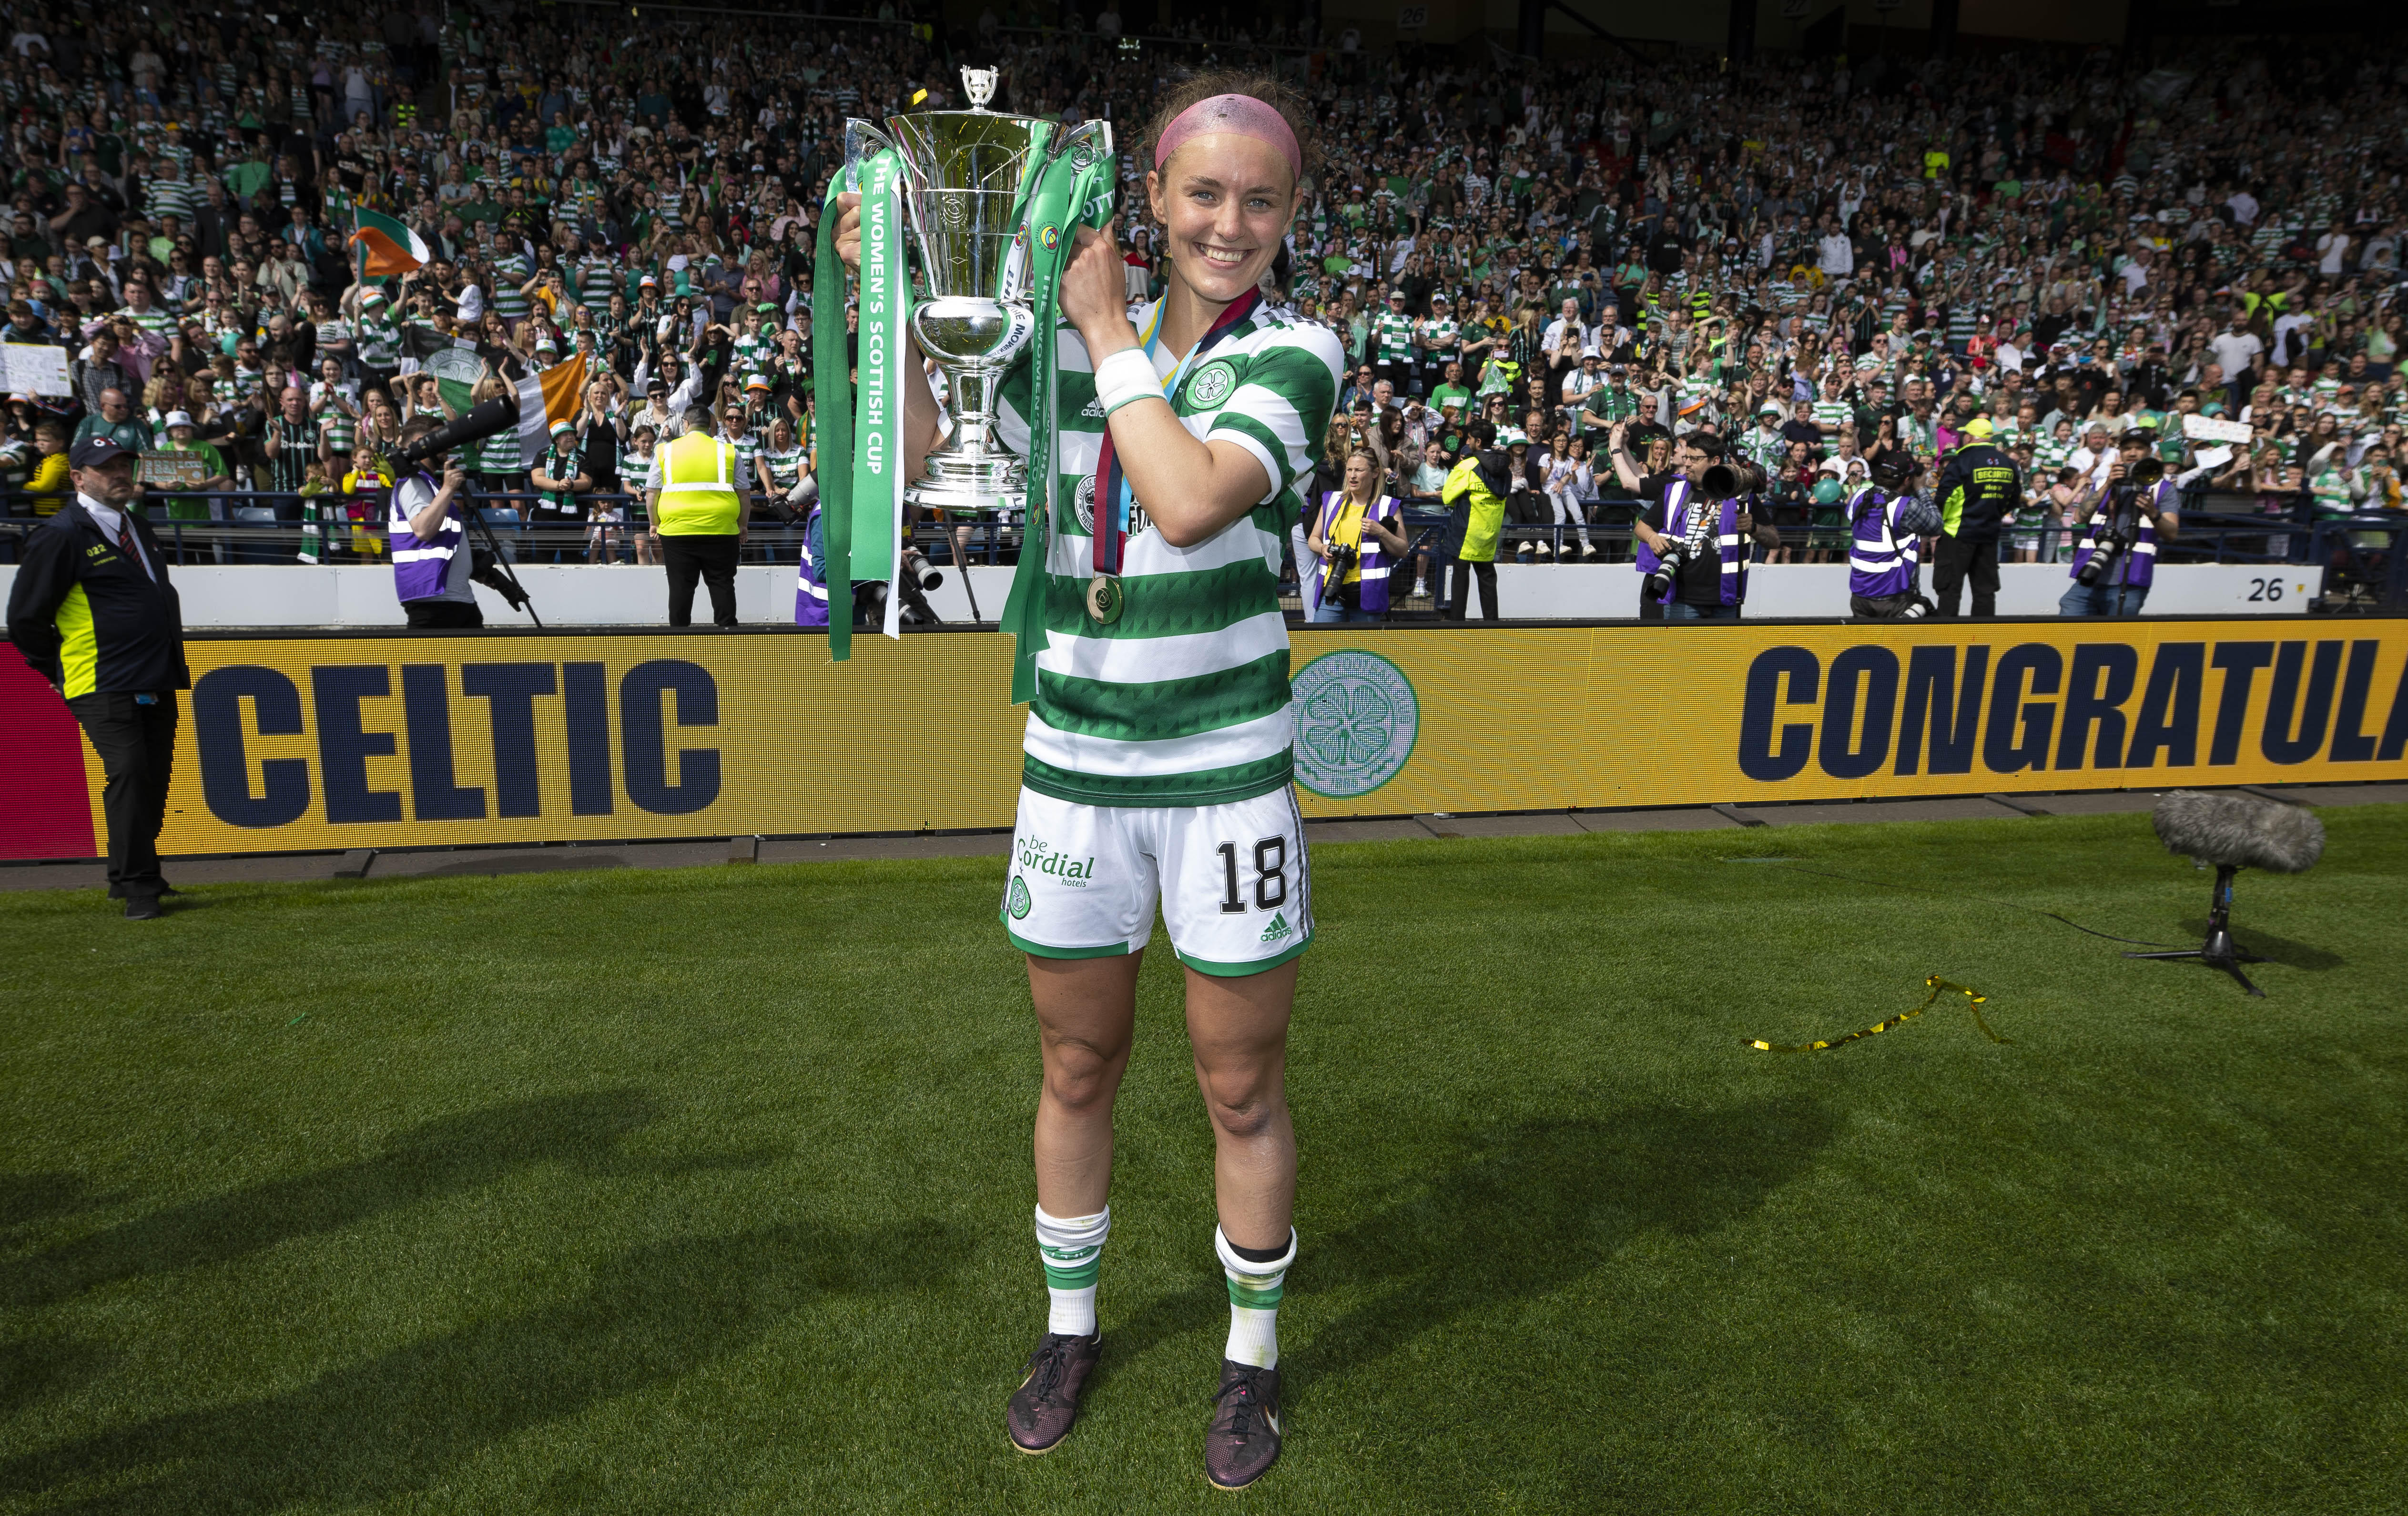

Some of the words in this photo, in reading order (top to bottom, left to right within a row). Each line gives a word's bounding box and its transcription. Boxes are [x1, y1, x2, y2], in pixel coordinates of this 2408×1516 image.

[1402, 8, 1424, 23] 26
[873, 156, 893, 195] THE
[870, 202, 884, 313] WOMEN'S
[1040, 275, 1051, 313] THE
[868, 321, 884, 424] SCOTTISH
[1034, 321, 1044, 430] WOMEN'S
[1194, 366, 1209, 381] CELTIC
[1209, 362, 1229, 371] FOOTBALL
[1081, 408, 1105, 417] adida
[867, 432, 883, 475] CUP
[1978, 470, 2012, 479] SECURITY
[1078, 482, 1087, 500] CELTIC
[86, 544, 107, 557] 022
[2248, 577, 2284, 601] 26
[1294, 664, 1333, 697] CELTIC
[1333, 657, 1396, 689] FOOTBALL
[1394, 689, 1412, 724] CLUB
[191, 658, 721, 828] CELTIC
[1330, 777, 1359, 788] 1888
[1029, 835, 1047, 852] be
[1017, 839, 1095, 879] Cordial
[1061, 878, 1087, 888] hotels
[1216, 834, 1288, 914] 18
[1260, 926, 1292, 942] adidas
